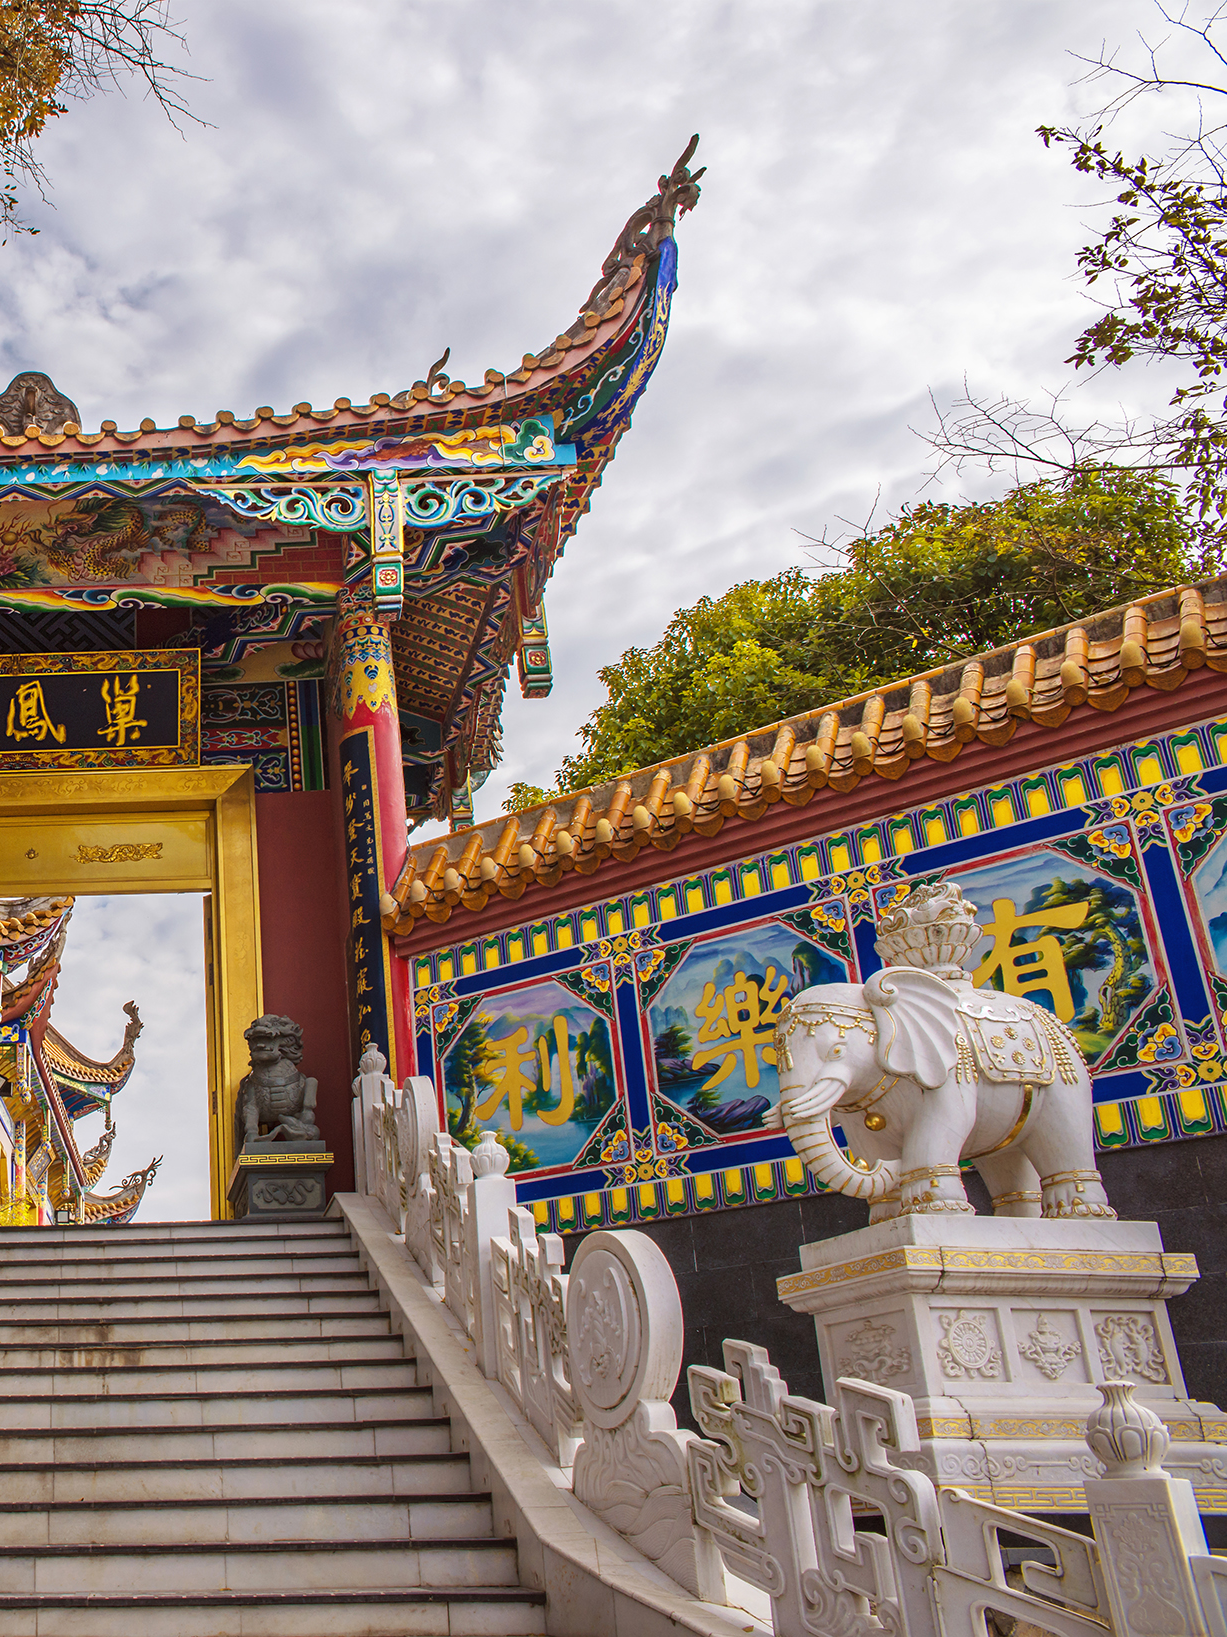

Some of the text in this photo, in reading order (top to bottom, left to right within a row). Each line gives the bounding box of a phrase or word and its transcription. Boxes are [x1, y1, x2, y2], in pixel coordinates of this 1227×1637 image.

[475, 898, 1091, 1131] 利 樂 有
